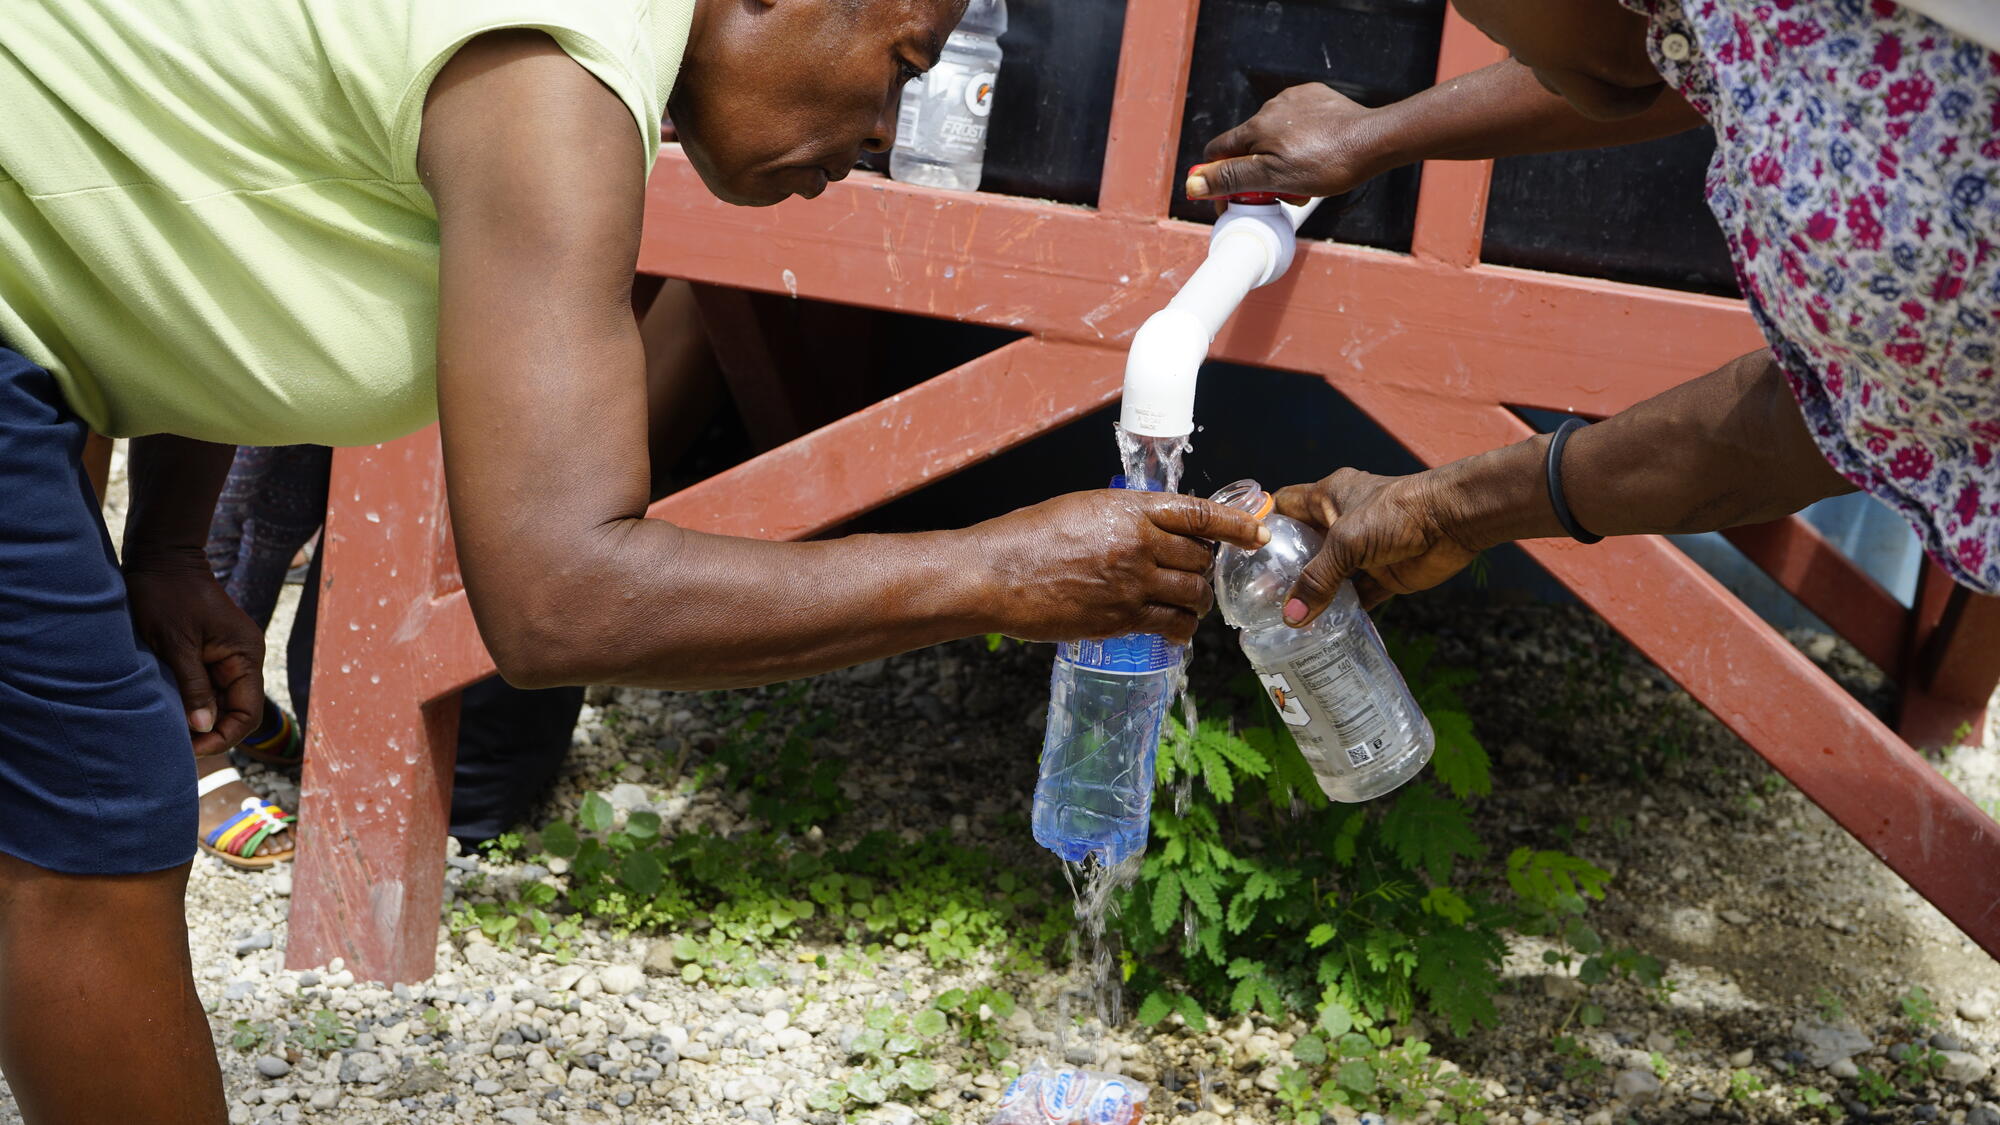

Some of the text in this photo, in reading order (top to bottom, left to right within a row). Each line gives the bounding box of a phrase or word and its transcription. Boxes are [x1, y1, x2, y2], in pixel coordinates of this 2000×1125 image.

[942, 121, 986, 138] FROST
[1295, 652, 1323, 669] Nutrition
[1323, 641, 1340, 655] Facts
[1338, 660, 1352, 673] 140
[1307, 676, 1330, 688] Calories
